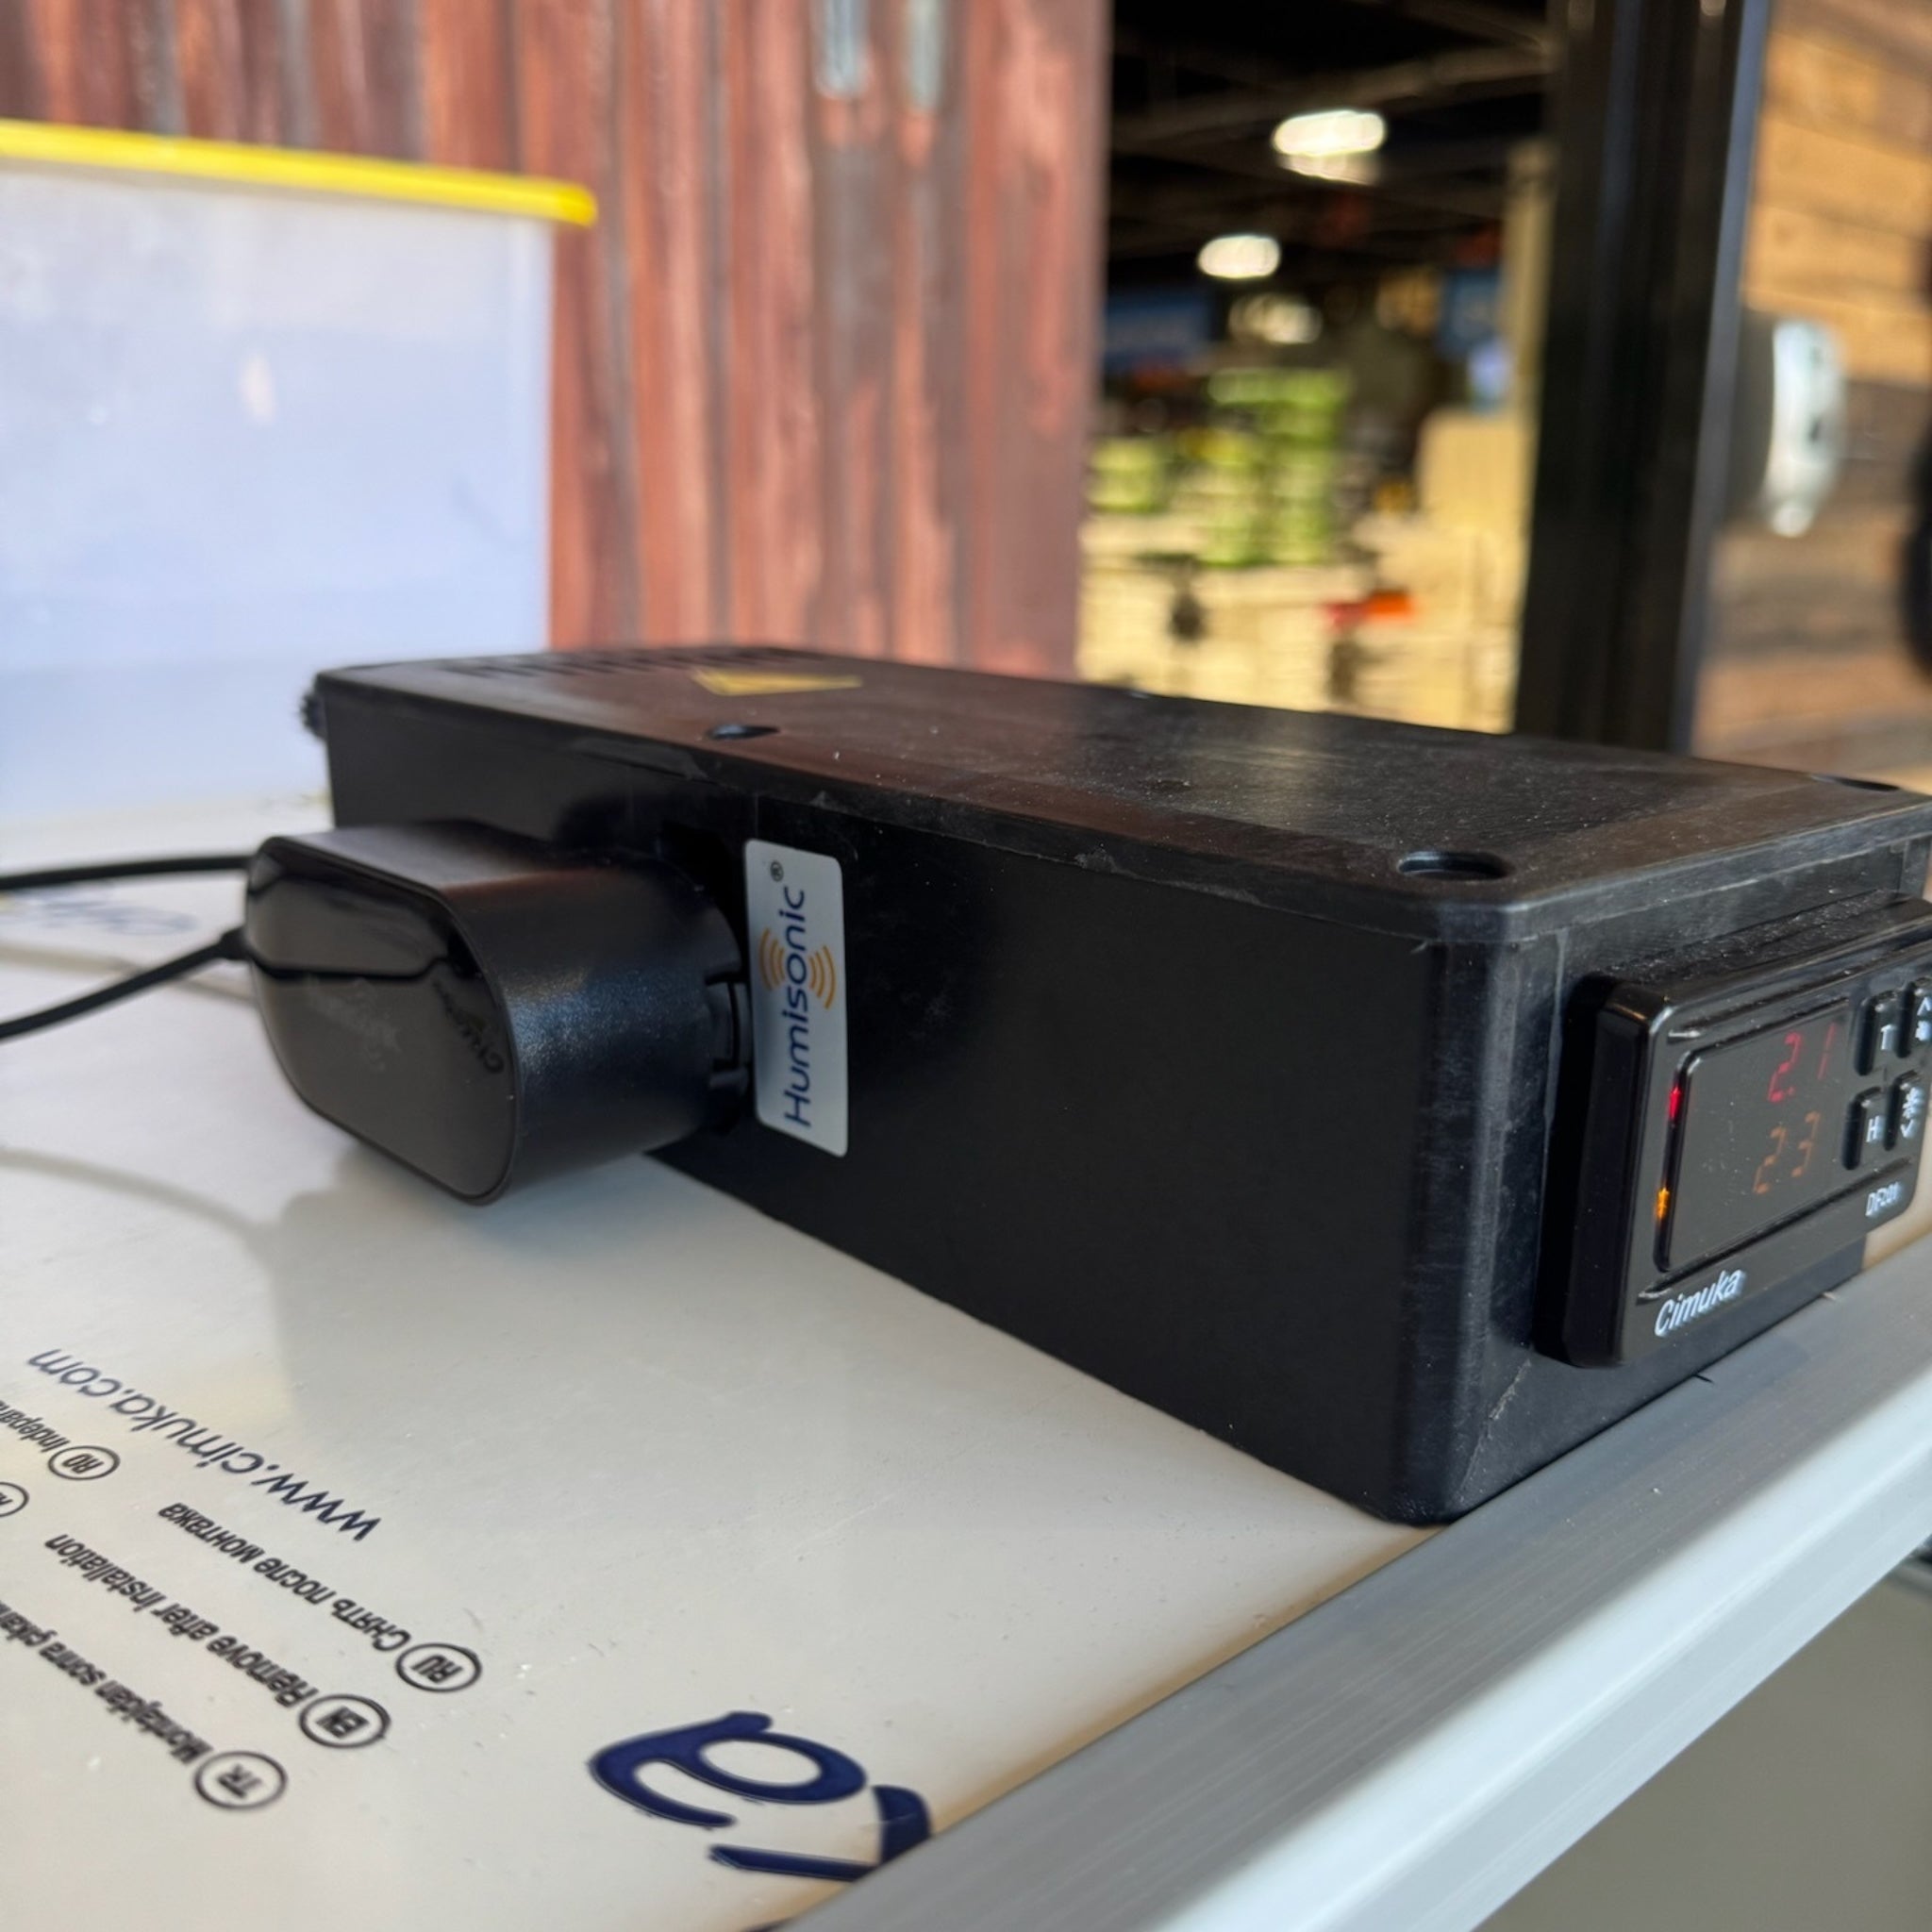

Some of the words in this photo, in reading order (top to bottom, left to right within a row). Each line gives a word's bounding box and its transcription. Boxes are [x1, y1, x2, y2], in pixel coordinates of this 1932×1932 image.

[1753, 1110, 1822, 1195] 23
[1866, 1115, 1885, 1143] H
[1655, 1270, 1747, 1337] Cimuka
[27, 1349, 381, 1541] www.cimuka.com
[61, 1454, 105, 1474] RO
[158, 1502, 266, 1563] монтажа
[44, 1534, 167, 1612] installation
[253, 1557, 338, 1605] после
[150, 1603, 220, 1641] after
[331, 1599, 412, 1652] Снять
[206, 1636, 319, 1708] Remove
[409, 1655, 464, 1684] RU
[314, 1706, 371, 1739] EN
[216, 1762, 263, 1798] TR
